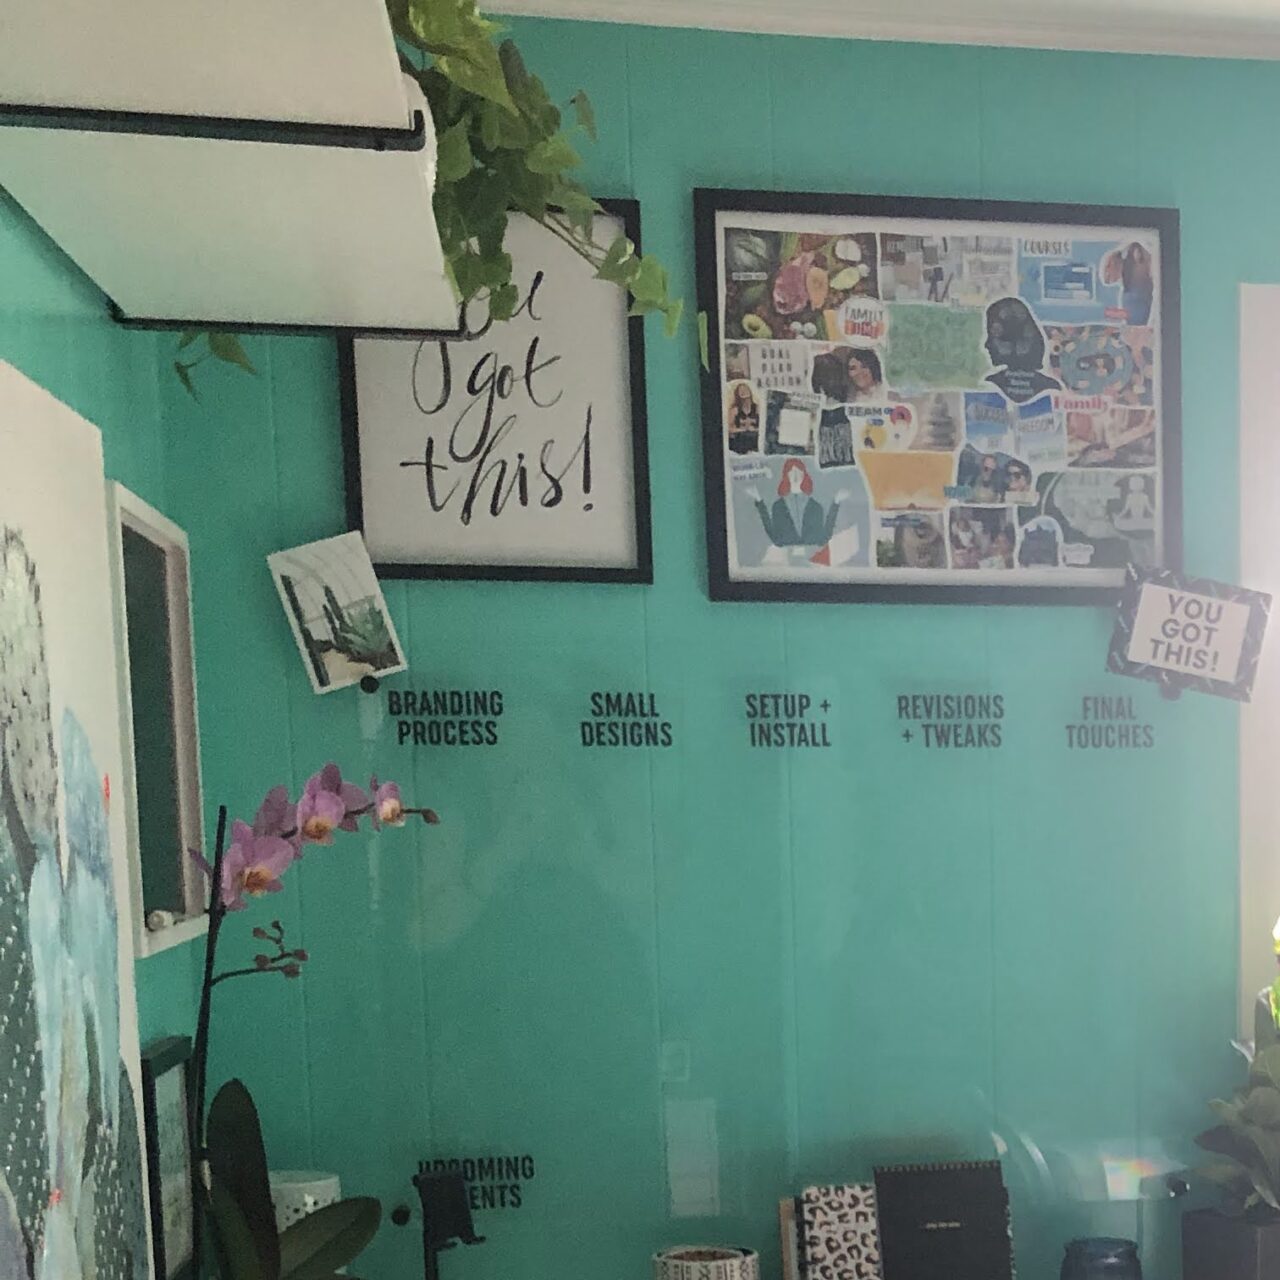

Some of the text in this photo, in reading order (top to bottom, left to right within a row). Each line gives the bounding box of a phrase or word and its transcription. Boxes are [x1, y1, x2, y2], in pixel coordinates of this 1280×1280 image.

[1023, 239, 1070, 258] COURSES
[844, 306, 885, 324] FAMILY
[448, 335, 563, 462] got
[1054, 396, 1109, 411] Family
[400, 405, 594, 526] this!
[1168, 593, 1224, 625] YOU
[1161, 618, 1219, 648] GOT
[1149, 637, 1220, 672] THIS!
[388, 690, 504, 717] BRANDING
[591, 692, 660, 718] SMALL
[745, 694, 832, 719] SETUP +
[897, 695, 1004, 720] REVISIONS
[1082, 696, 1137, 720] FINAL
[397, 720, 498, 746] PROCESS
[580, 721, 673, 747] DESIGNS
[750, 723, 832, 747] INSTALL
[901, 723, 1002, 748] + TWEAKS
[1065, 724, 1154, 748] TOUCHES
